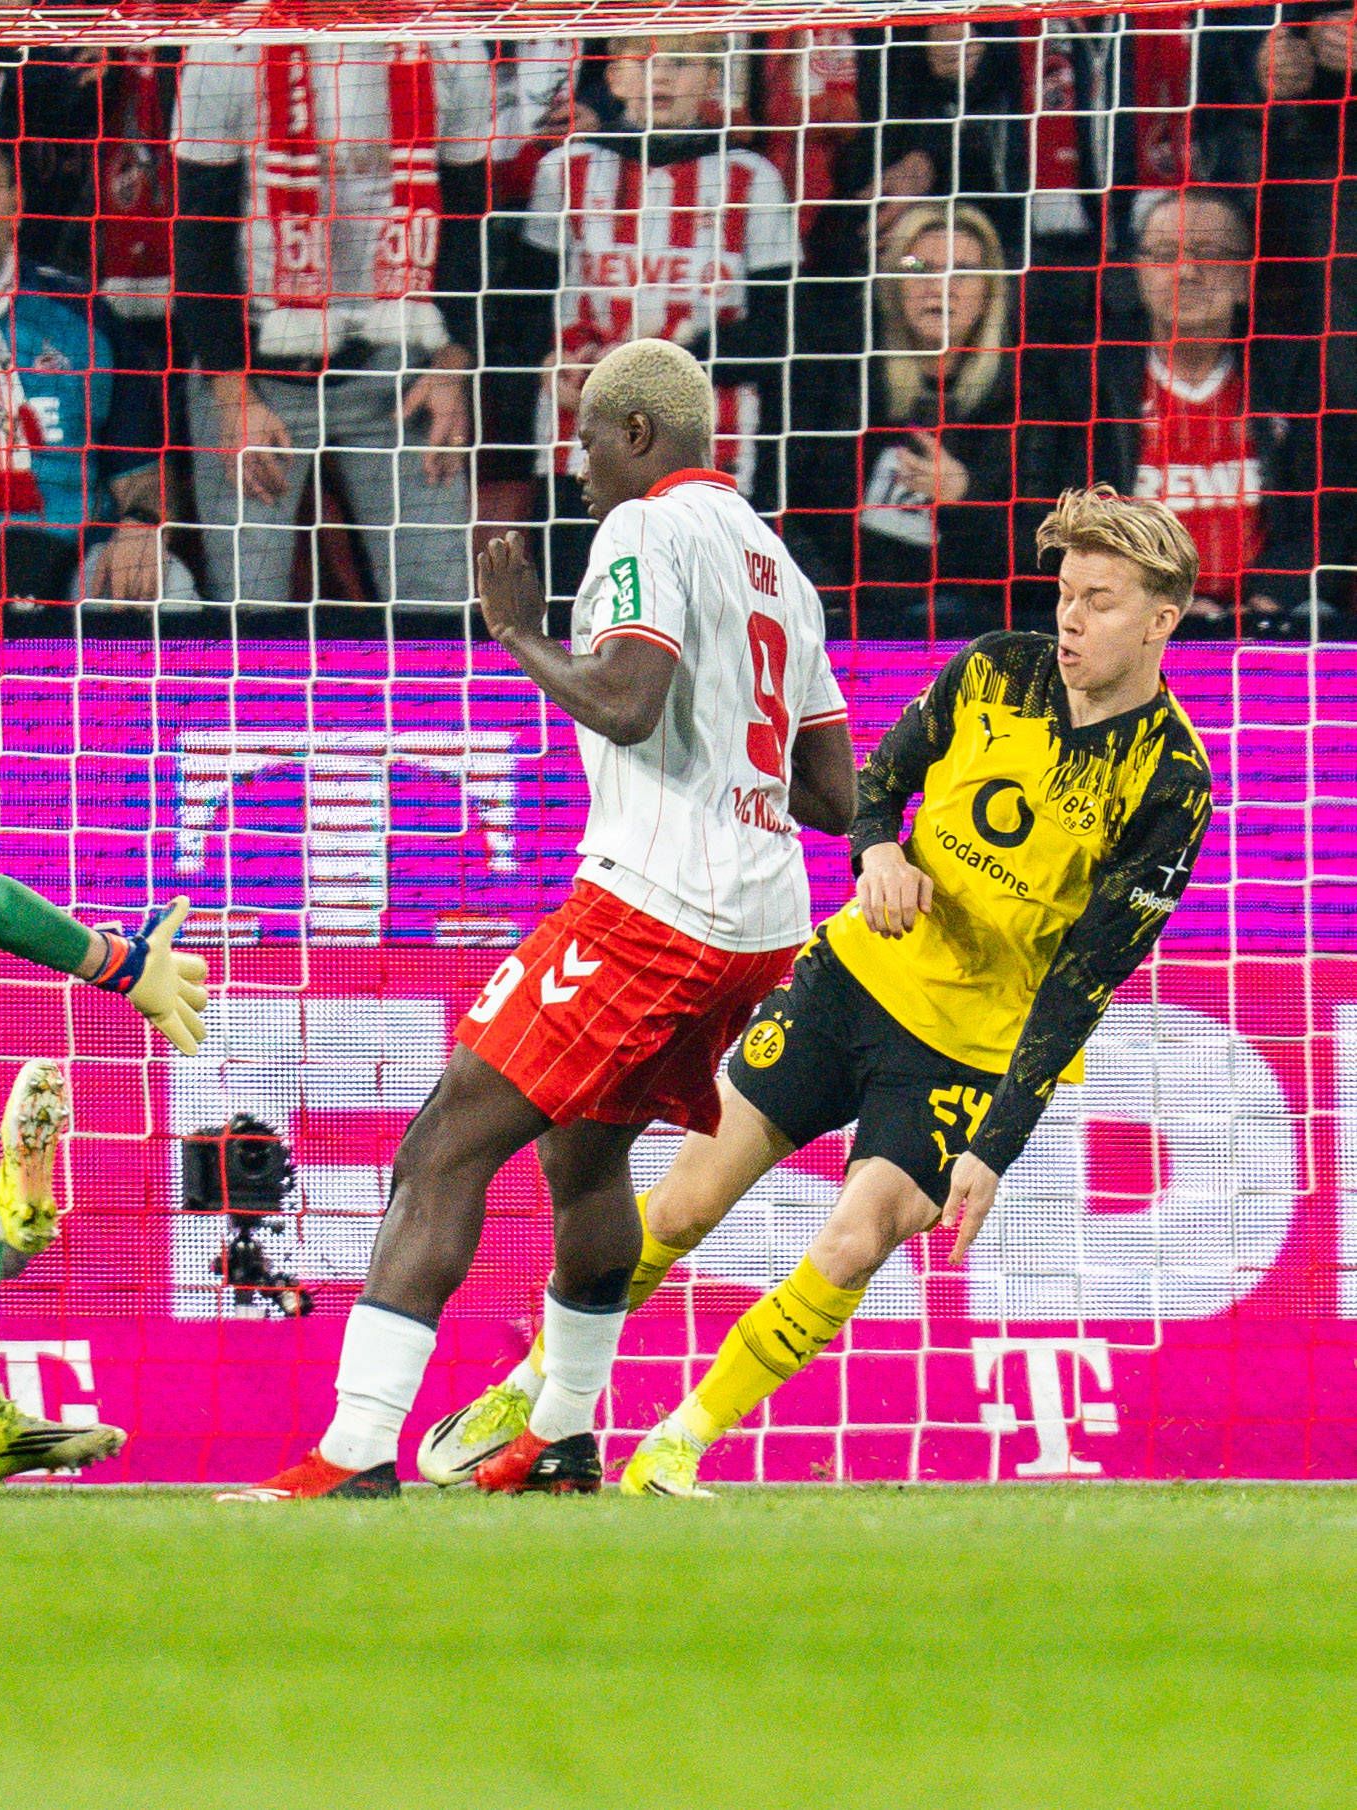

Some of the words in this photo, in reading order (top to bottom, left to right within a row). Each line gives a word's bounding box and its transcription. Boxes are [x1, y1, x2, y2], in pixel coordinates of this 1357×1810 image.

[746, 610, 790, 785] 9
[1062, 796, 1096, 830] BVB
[936, 825, 1029, 897] vodafone
[467, 955, 525, 1024] 9
[971, 1338, 1119, 1475] T
